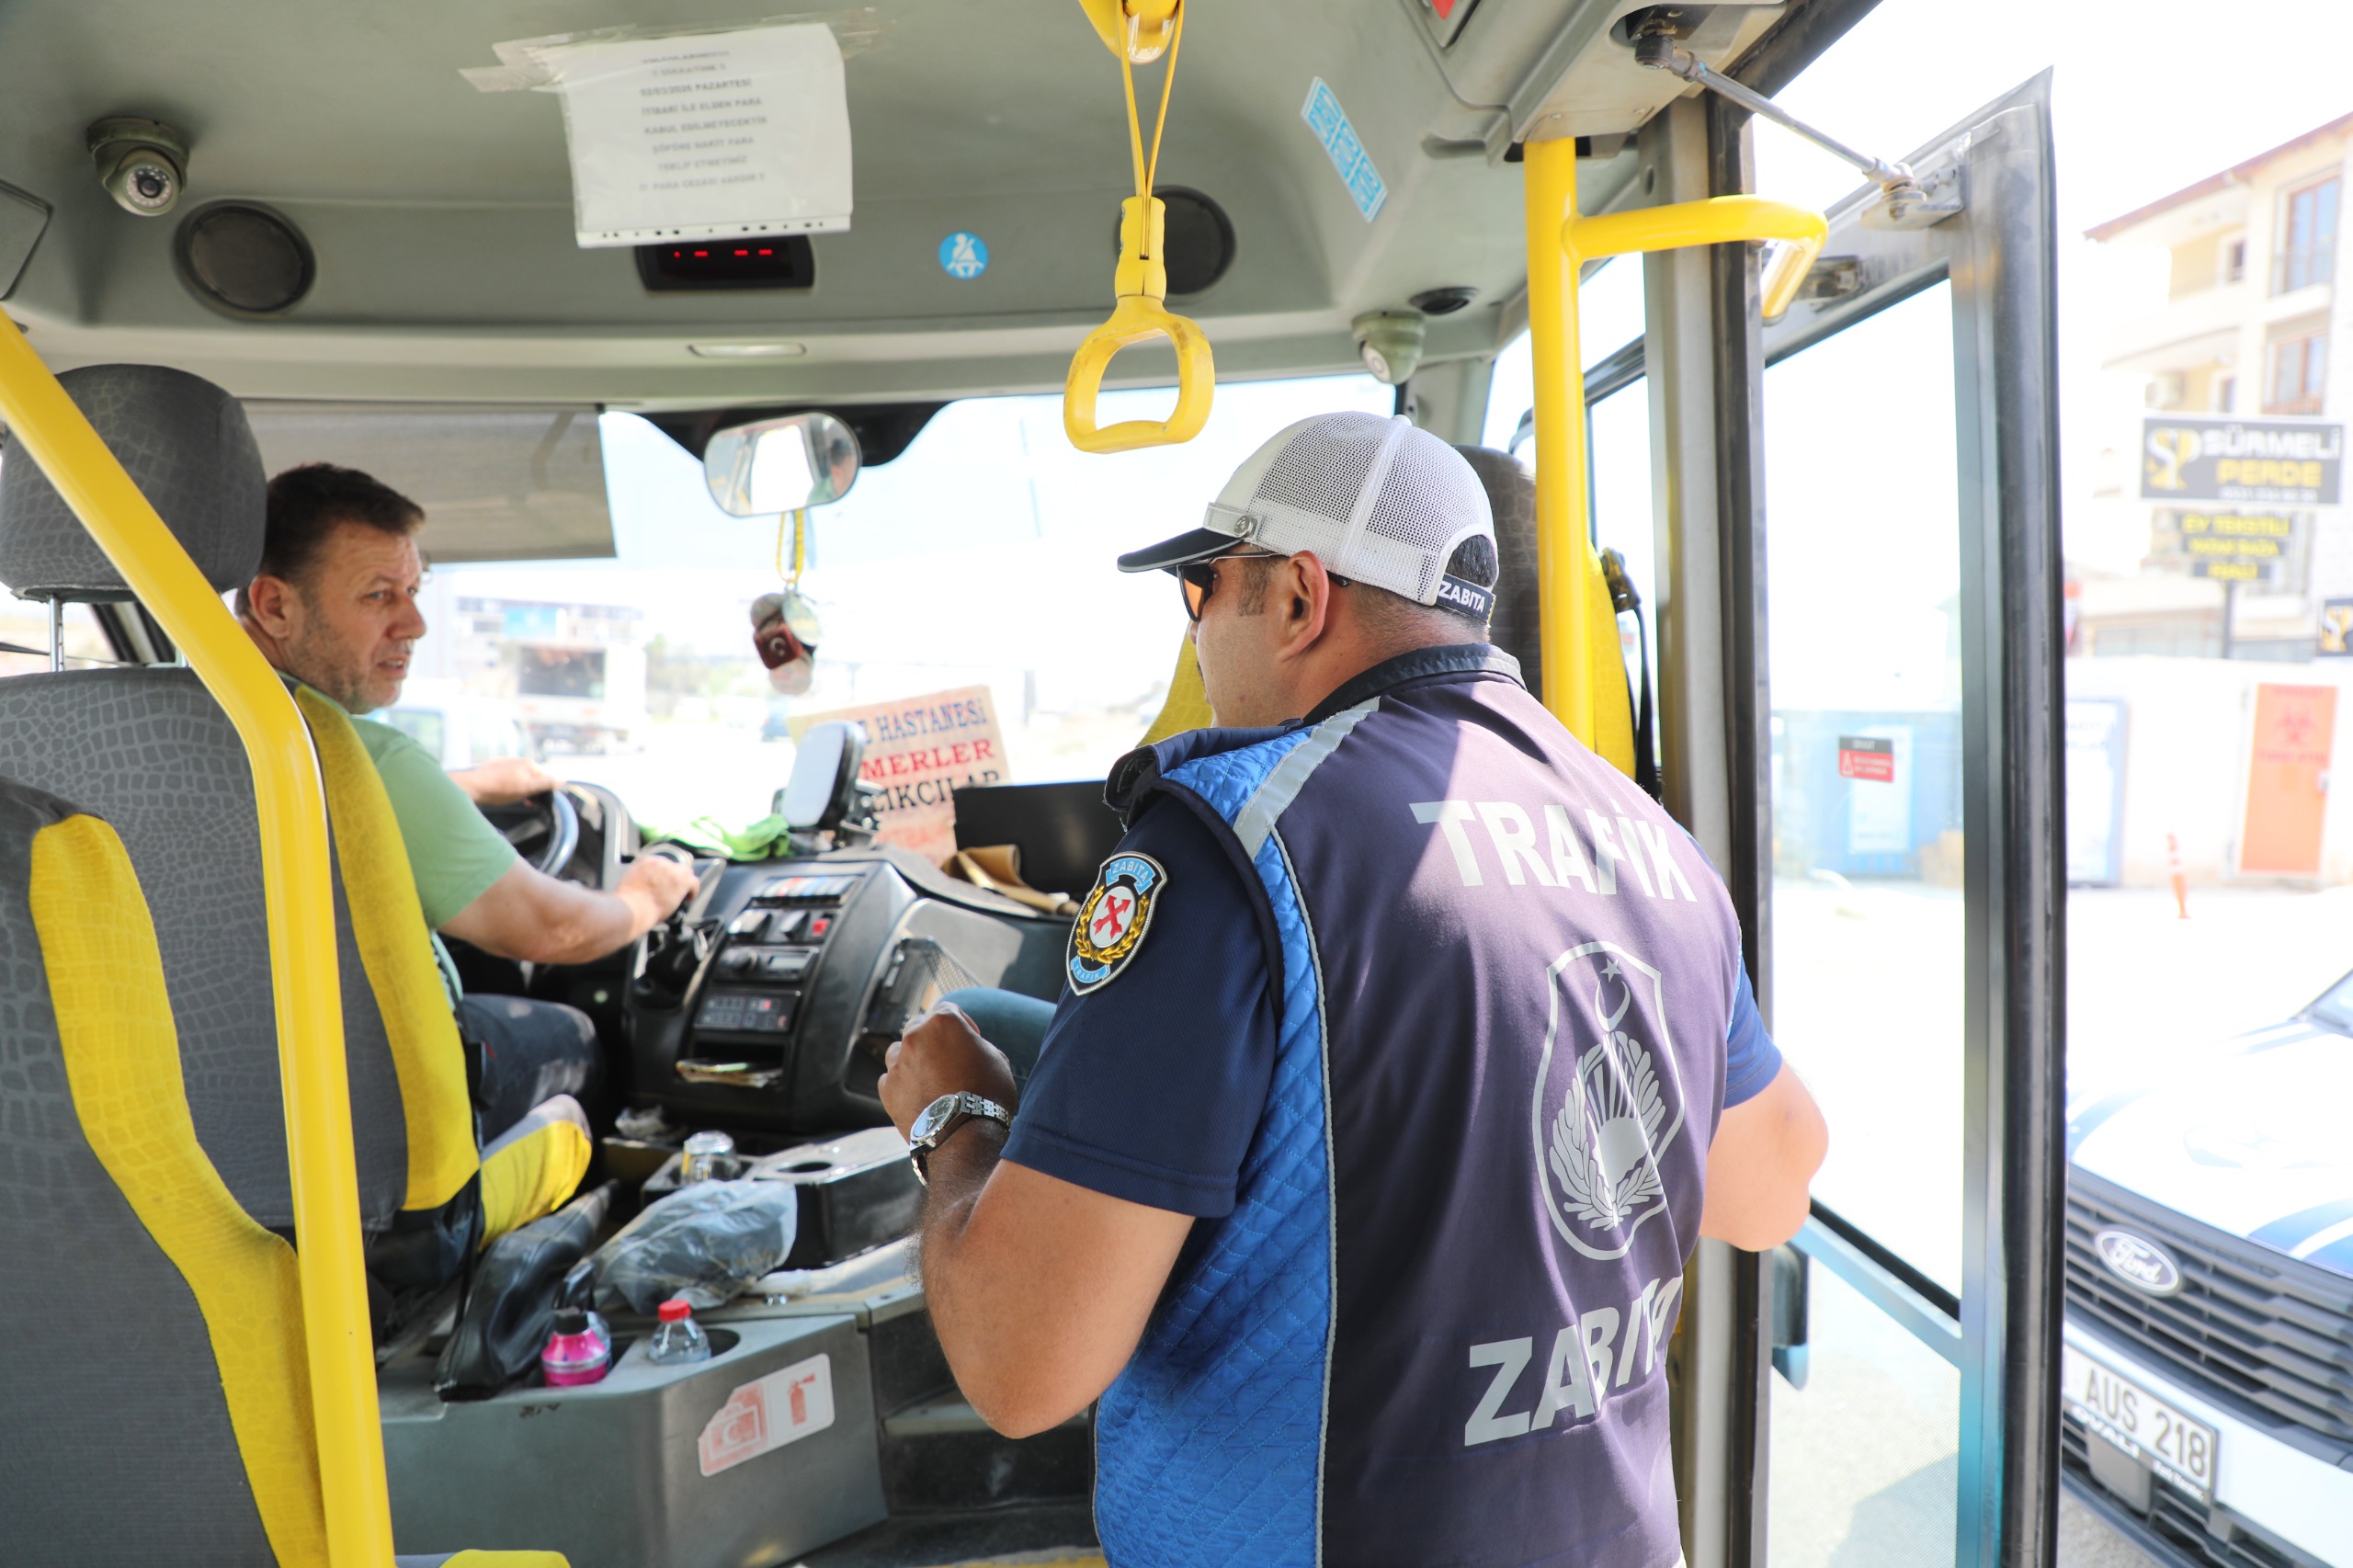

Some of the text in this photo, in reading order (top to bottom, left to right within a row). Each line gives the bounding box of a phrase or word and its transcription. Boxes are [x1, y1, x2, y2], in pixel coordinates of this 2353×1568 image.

[735, 97, 763, 107] PARA
[644, 124, 677, 134] KABUL
[728, 137, 755, 146] PARA
[2201, 424, 2341, 460] SÜRMELİ
[2217, 458, 2323, 488] PERDE
[1438, 581, 1485, 613] ZABITA
[861, 739, 995, 781] MERLER
[1409, 798, 1698, 903] TRAFİK
[1113, 861, 1149, 882] ZABITA
[2108, 1238, 2163, 1284] Ford
[1465, 1274, 1684, 1447] ZABITA
[2086, 1367, 2209, 1479] AUS 218
